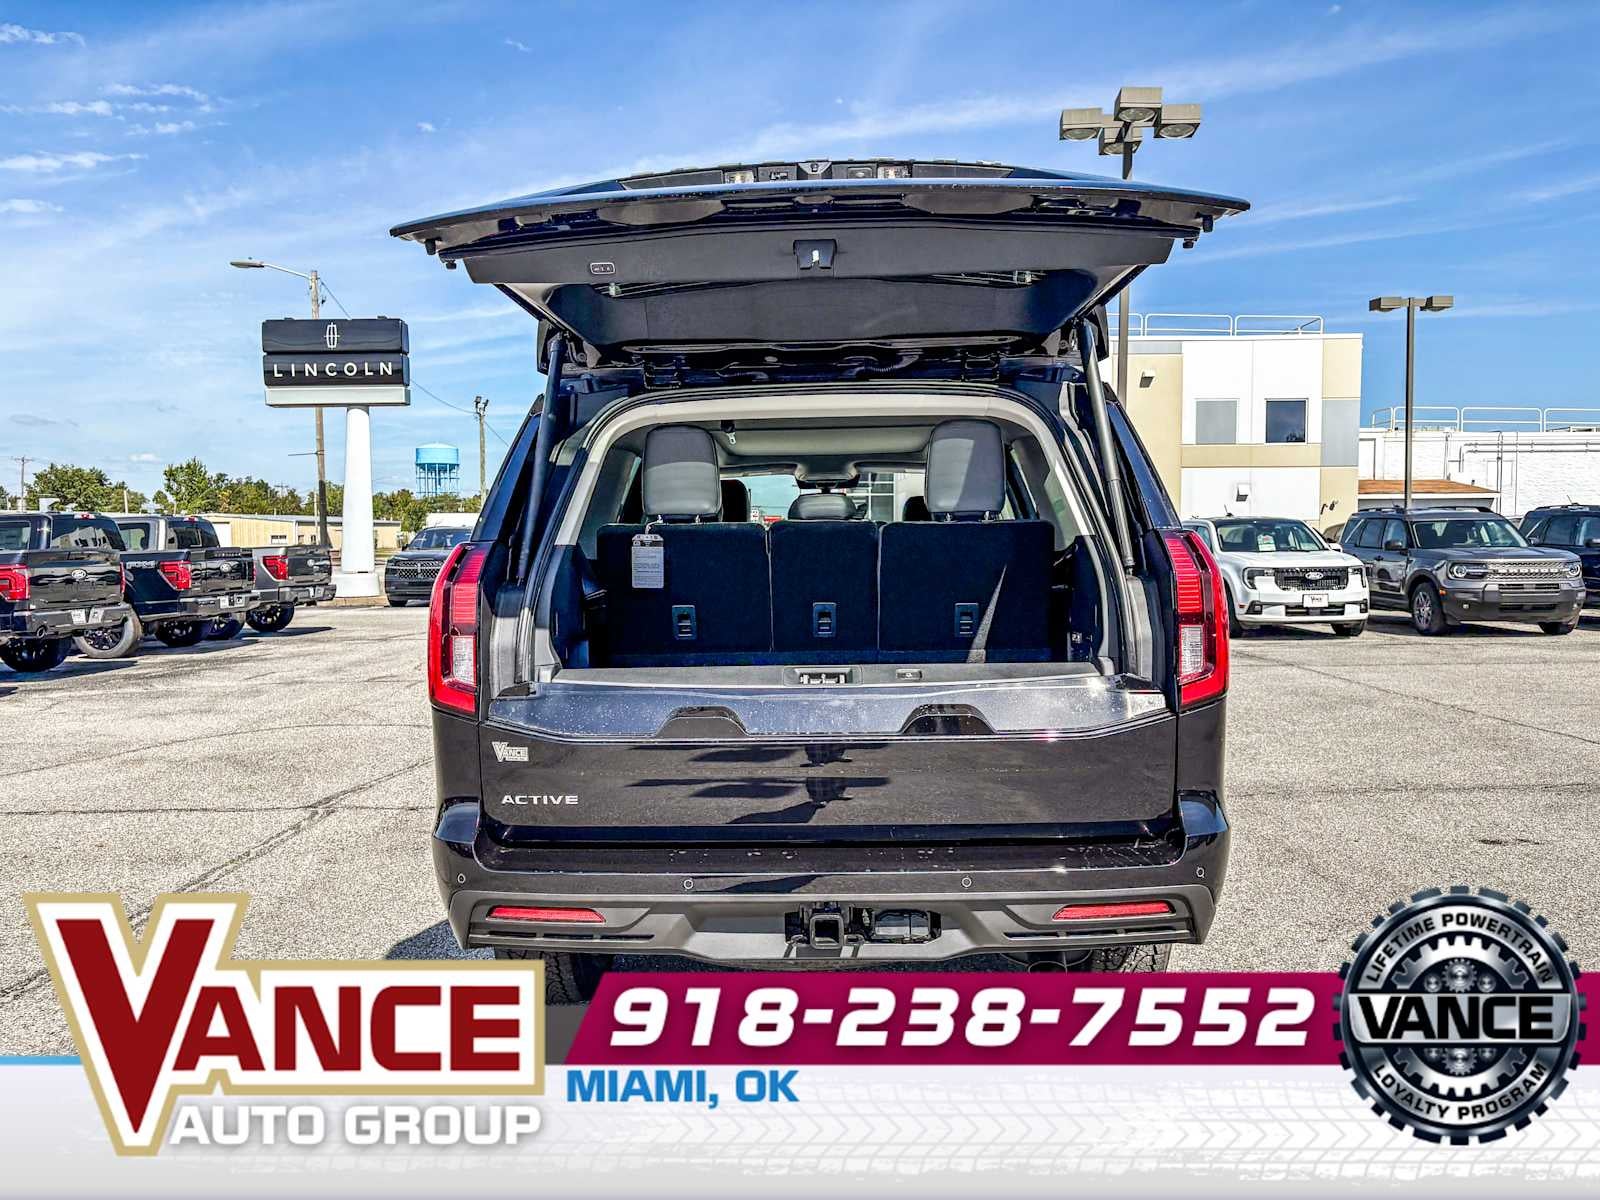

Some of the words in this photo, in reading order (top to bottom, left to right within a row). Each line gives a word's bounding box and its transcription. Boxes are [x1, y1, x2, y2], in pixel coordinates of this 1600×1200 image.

[273, 362, 393, 377] LINCOLN
[491, 741, 529, 762] VANCE
[501, 795, 579, 805] ACTIVE
